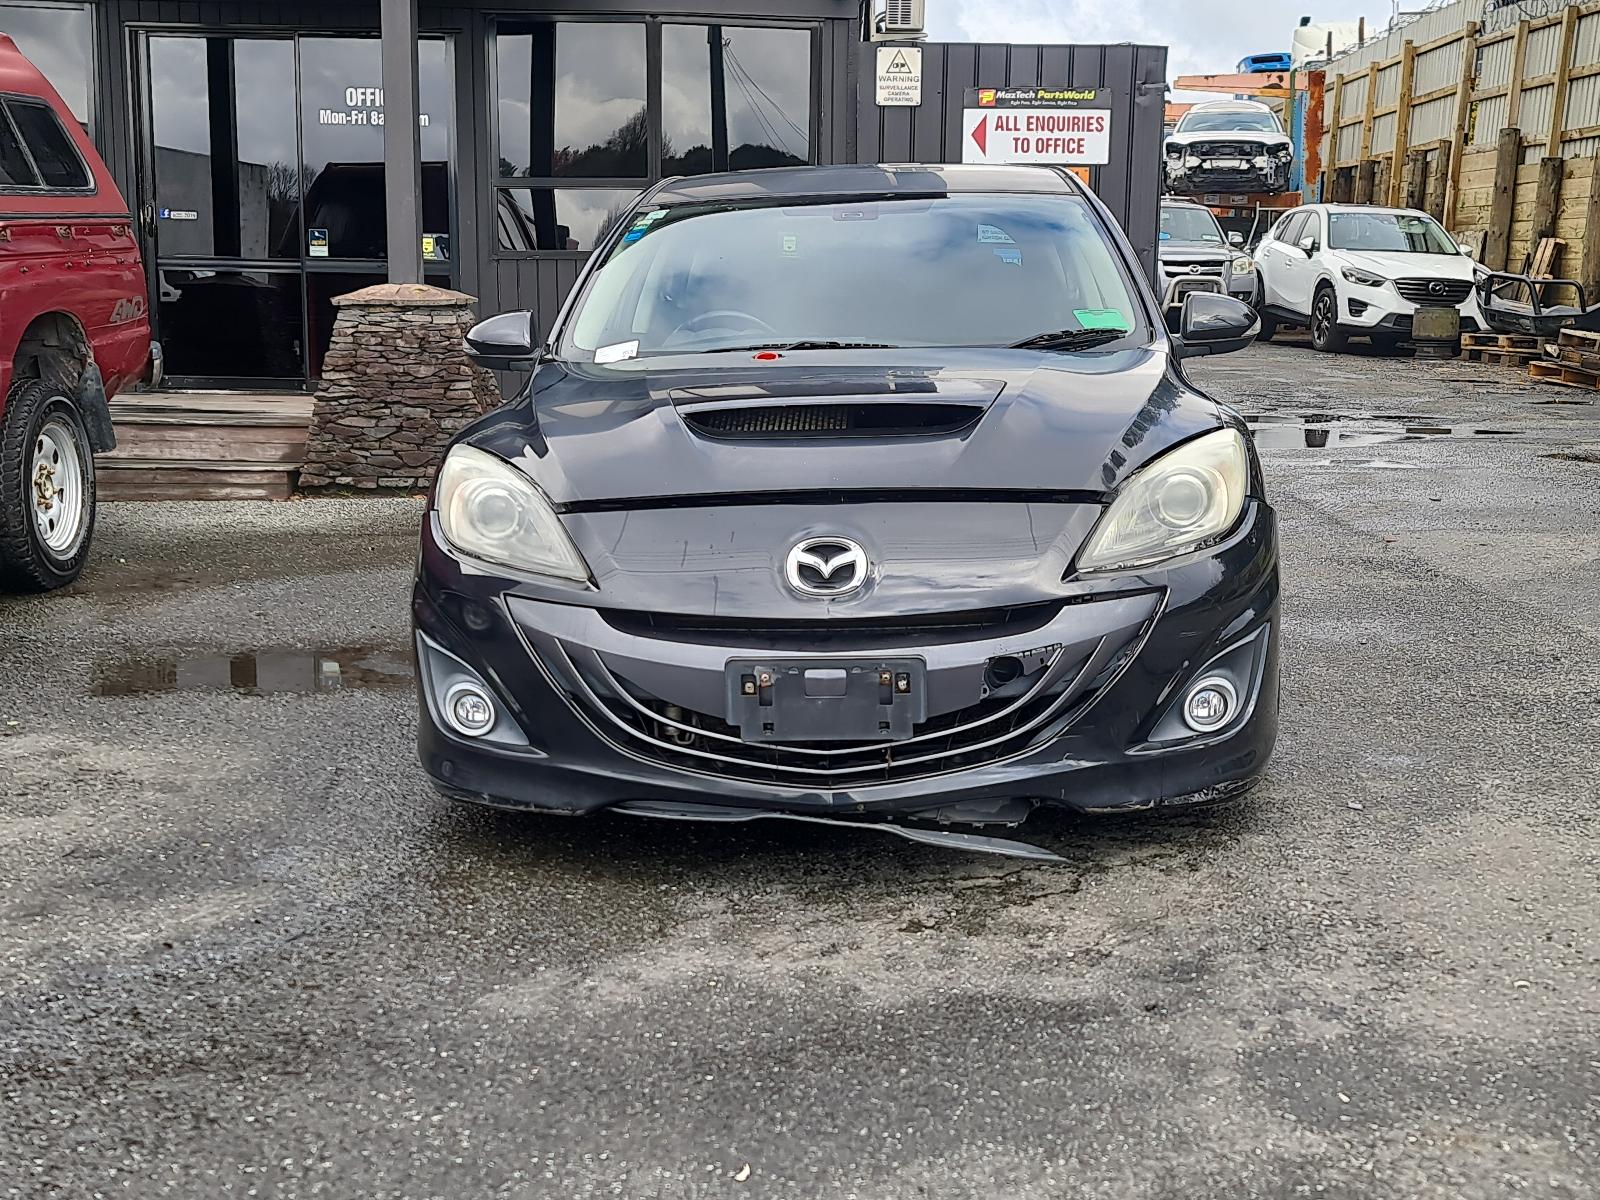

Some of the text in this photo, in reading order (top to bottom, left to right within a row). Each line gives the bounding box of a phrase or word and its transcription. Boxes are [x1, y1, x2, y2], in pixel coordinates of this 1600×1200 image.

[879, 75, 920, 83] WARNING
[1037, 90, 1096, 100] PartsWorld
[319, 109, 367, 125] Mon-Fri
[994, 115, 1105, 133] ALL ENQUIRIES
[1012, 137, 1086, 154] TO OFFICE
